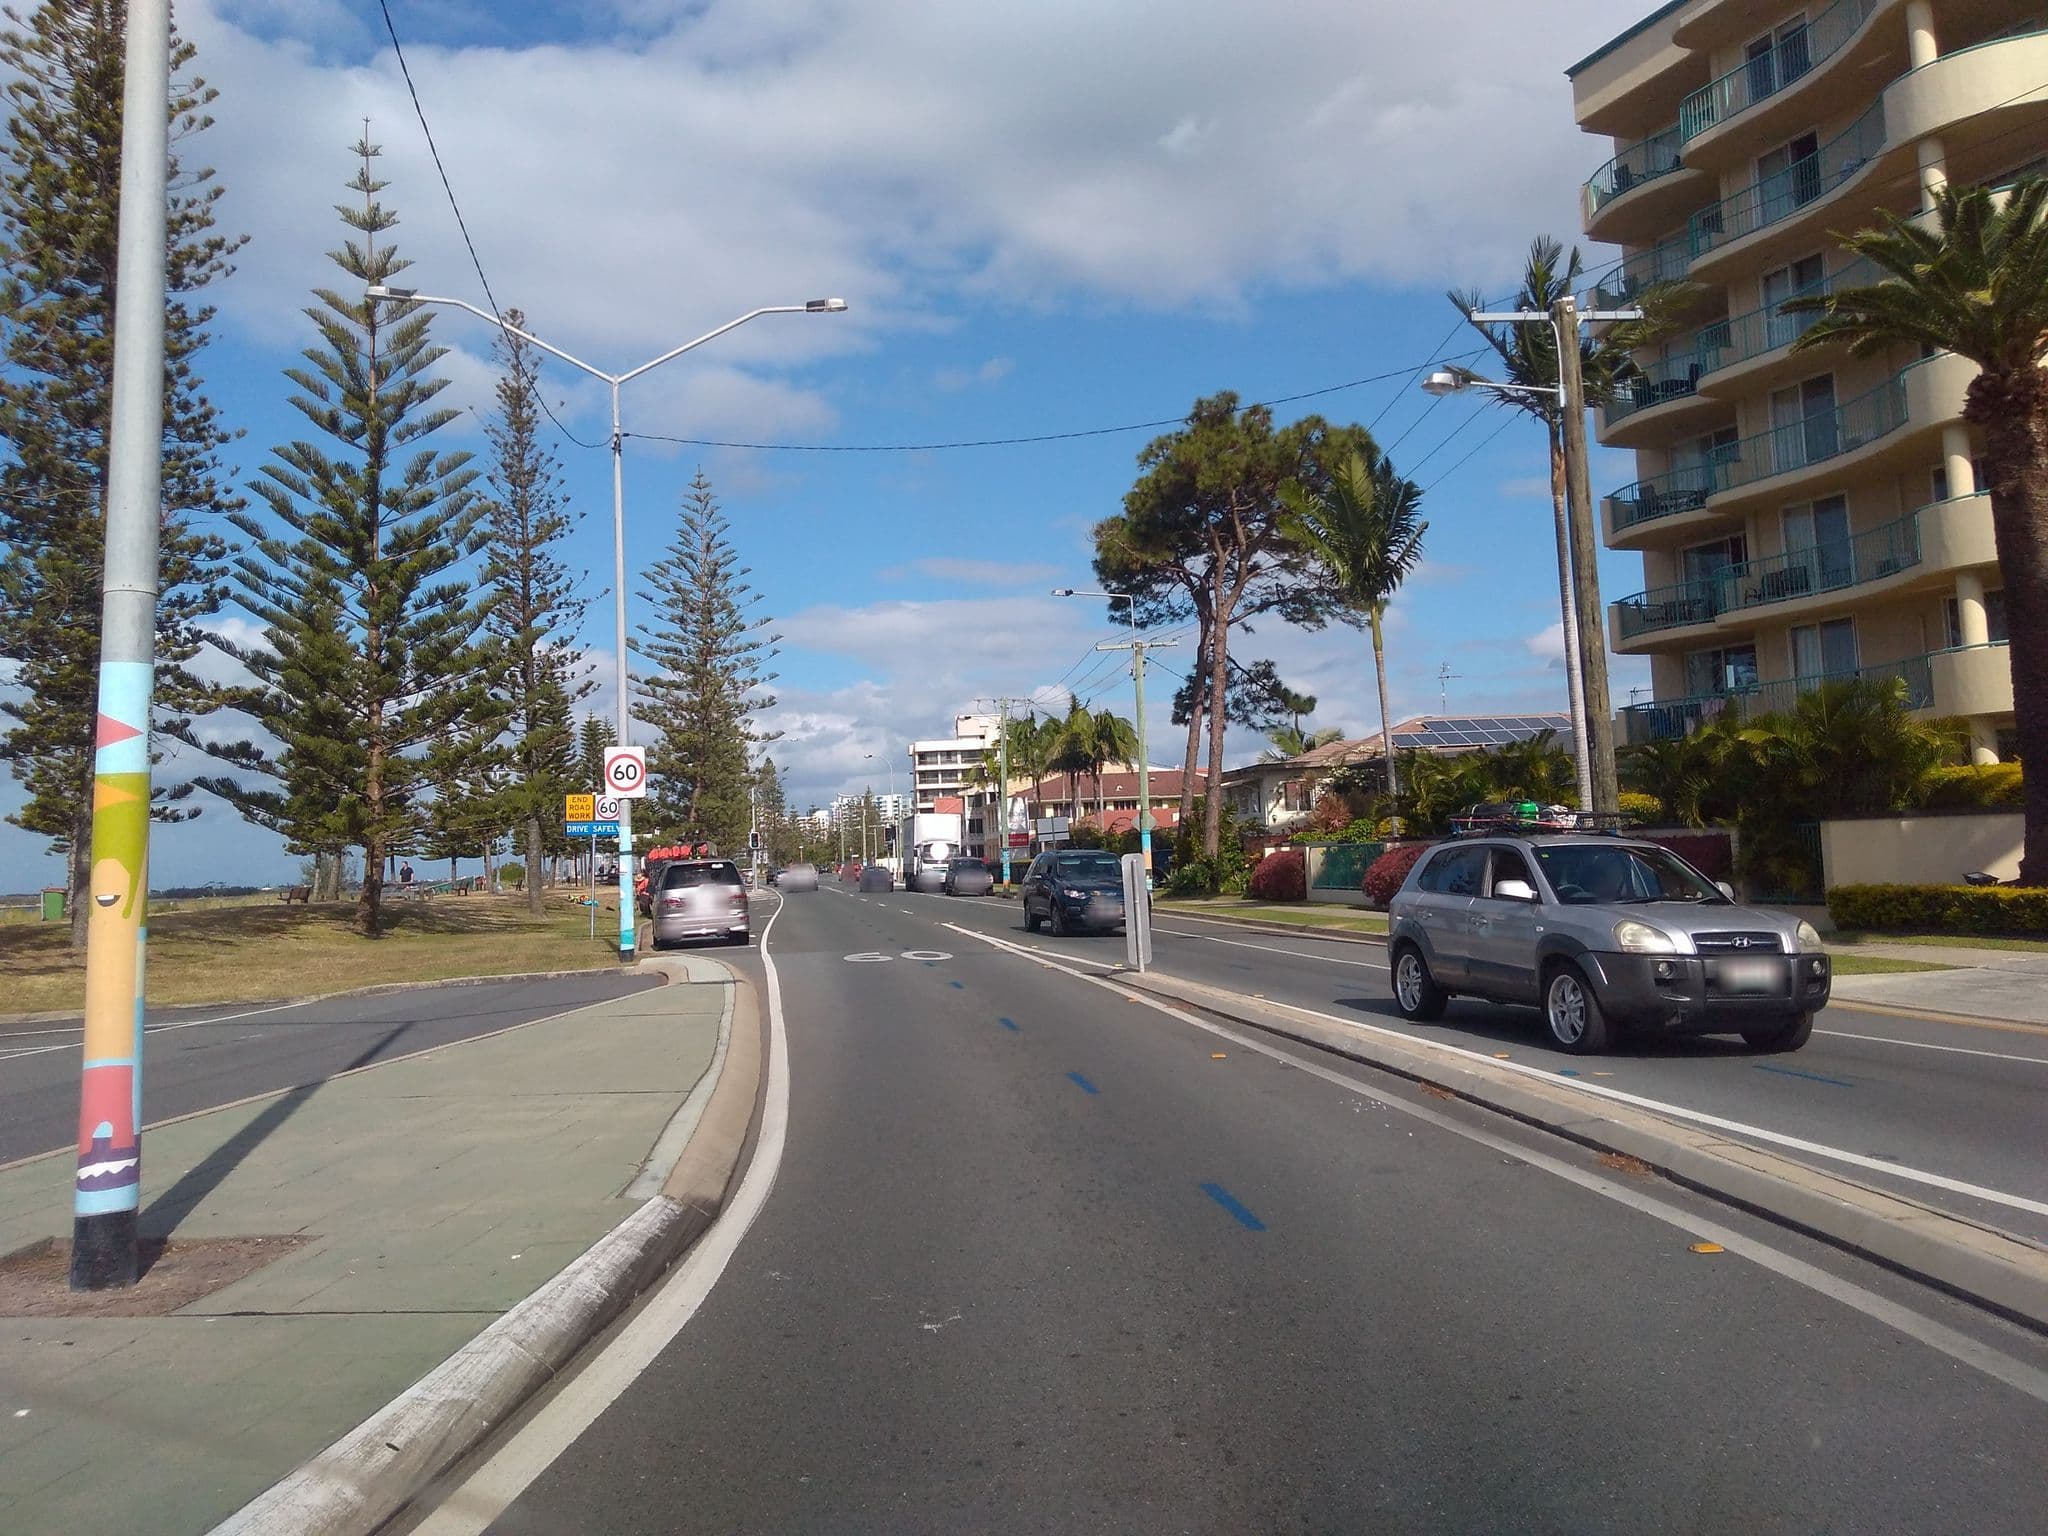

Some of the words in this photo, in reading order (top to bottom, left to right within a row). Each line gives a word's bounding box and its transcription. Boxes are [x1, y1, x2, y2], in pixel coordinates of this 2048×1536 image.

[613, 764, 637, 780] 60
[600, 801, 618, 813] 60
[566, 825, 589, 833] DRIVE
[592, 825, 620, 833] SAFELY
[843, 950, 954, 962] 60
